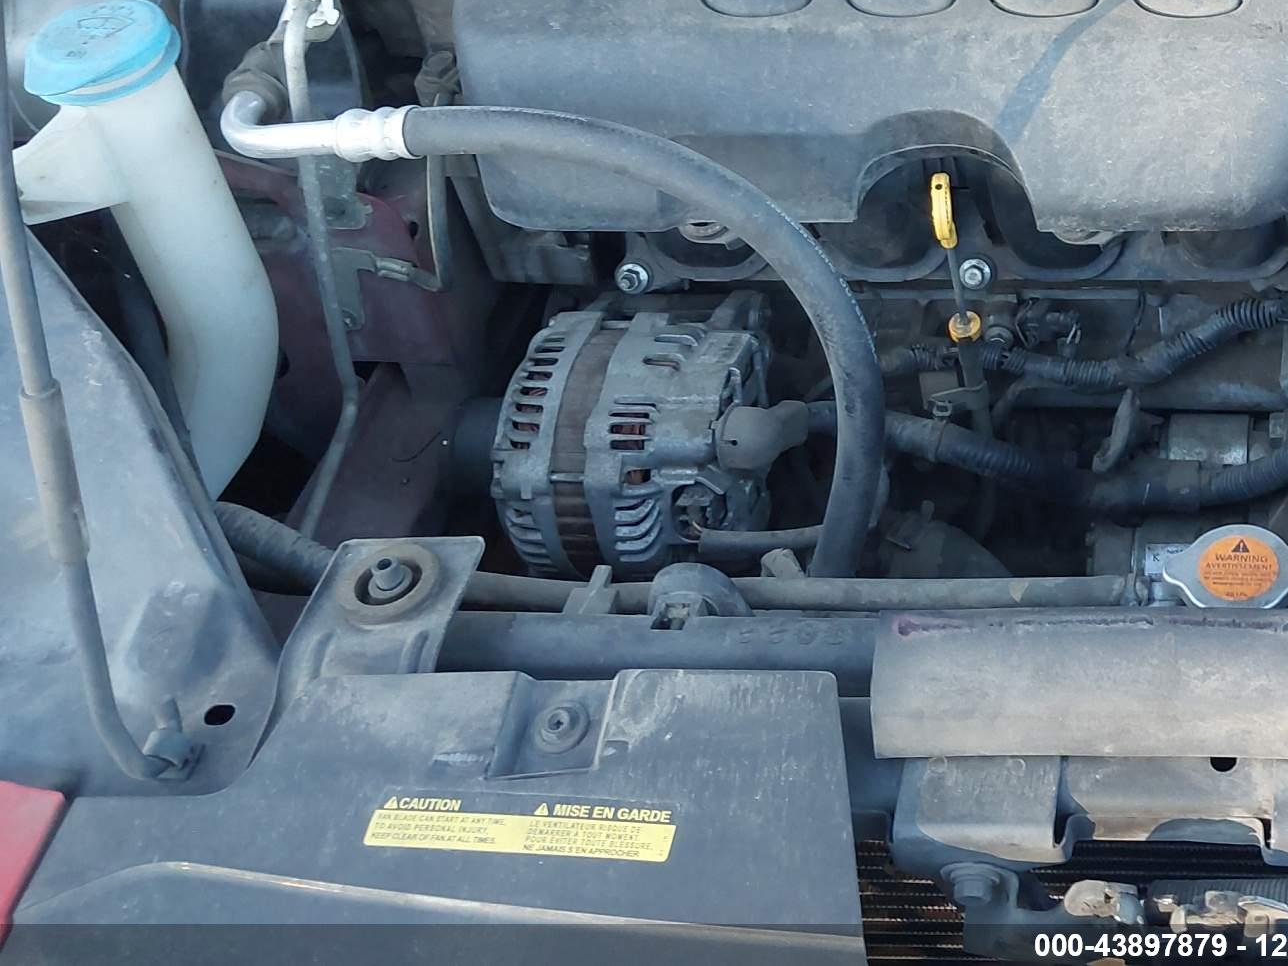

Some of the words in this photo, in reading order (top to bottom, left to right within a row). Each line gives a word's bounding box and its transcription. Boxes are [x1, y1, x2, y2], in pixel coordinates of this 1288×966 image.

[1215, 553, 1269, 564] WARNING
[399, 797, 462, 811] CAUTION
[553, 803, 591, 818] MISE
[592, 805, 614, 819] EN
[616, 807, 672, 823] GARDE
